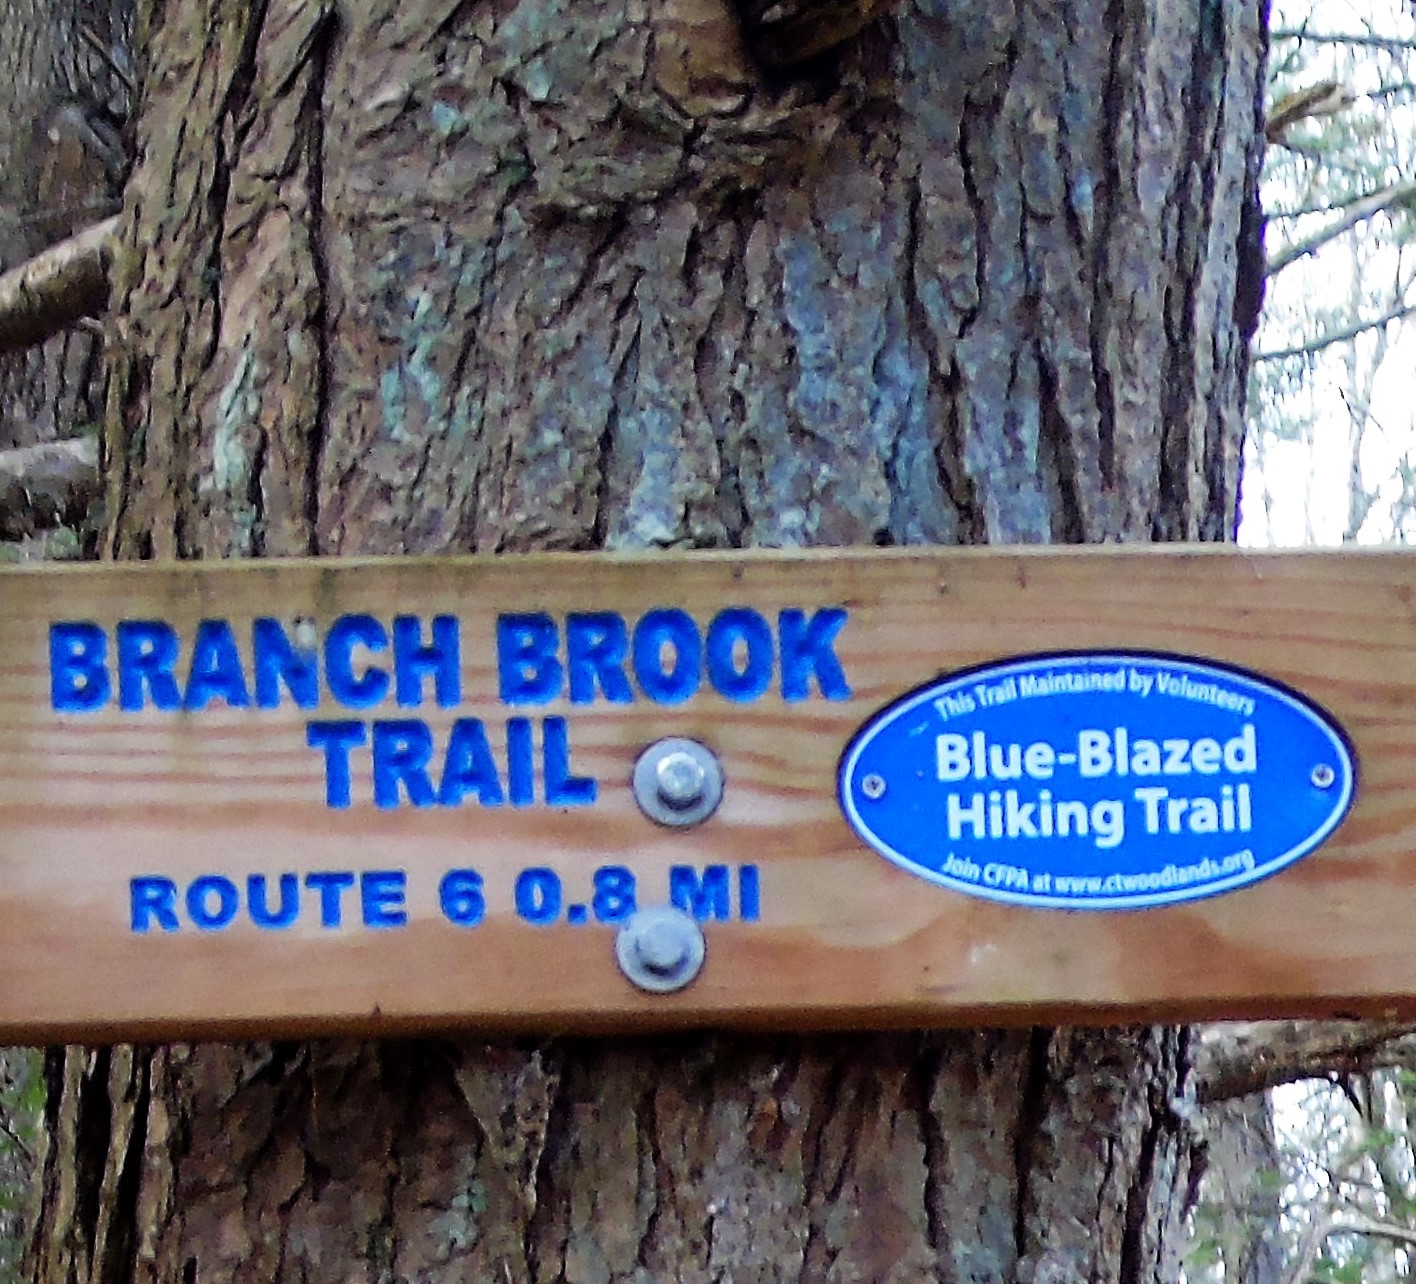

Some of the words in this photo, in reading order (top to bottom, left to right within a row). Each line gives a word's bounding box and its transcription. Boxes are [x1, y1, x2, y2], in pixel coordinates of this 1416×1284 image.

[48, 614, 461, 712] BRANCH
[496, 606, 852, 708] BROOK
[935, 690, 973, 721] This
[973, 682, 1017, 709] Trail
[1021, 670, 1125, 701] Maintained
[1129, 669, 1153, 697] by
[1156, 672, 1256, 716] Volunteers
[306, 716, 597, 810] TRAIL
[935, 725, 1257, 782] Blue-Blazed
[947, 787, 1124, 848] Hiking
[1135, 783, 1253, 836] Trail
[129, 870, 408, 933] ROUTE
[438, 869, 485, 925] 6
[514, 865, 637, 925] 0.8
[668, 864, 762, 923] MI
[942, 852, 981, 880] Join
[984, 862, 1030, 891] CFPA
[1033, 874, 1052, 893] at
[1054, 848, 1255, 894] www.ctwoodlands.org
